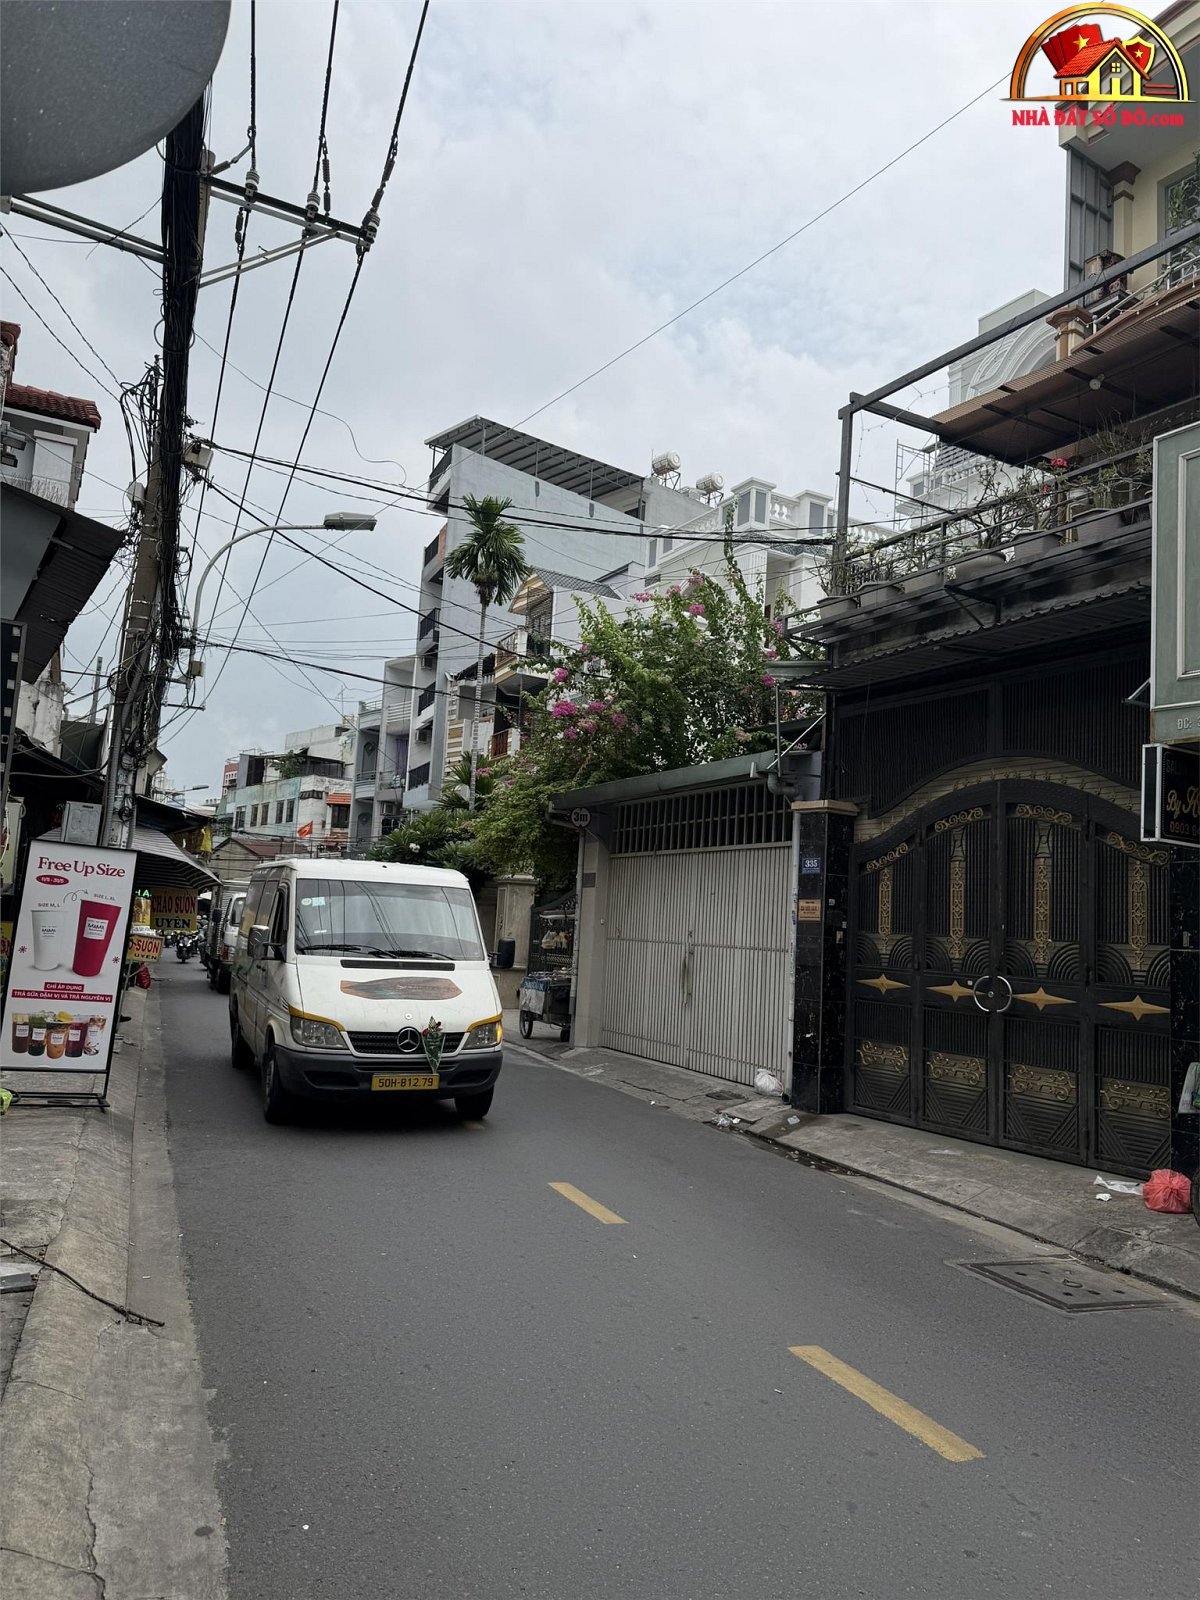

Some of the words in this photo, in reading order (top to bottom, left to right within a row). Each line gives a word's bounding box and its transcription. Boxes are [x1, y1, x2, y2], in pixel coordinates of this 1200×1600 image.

[1166, 789, 1182, 820] By
[574, 812, 588, 821] 3m
[38, 857, 71, 872] Free
[73, 861, 95, 877] Up
[96, 863, 126, 877] Size
[805, 860, 818, 868] 335
[155, 916, 191, 928] UYÊN
